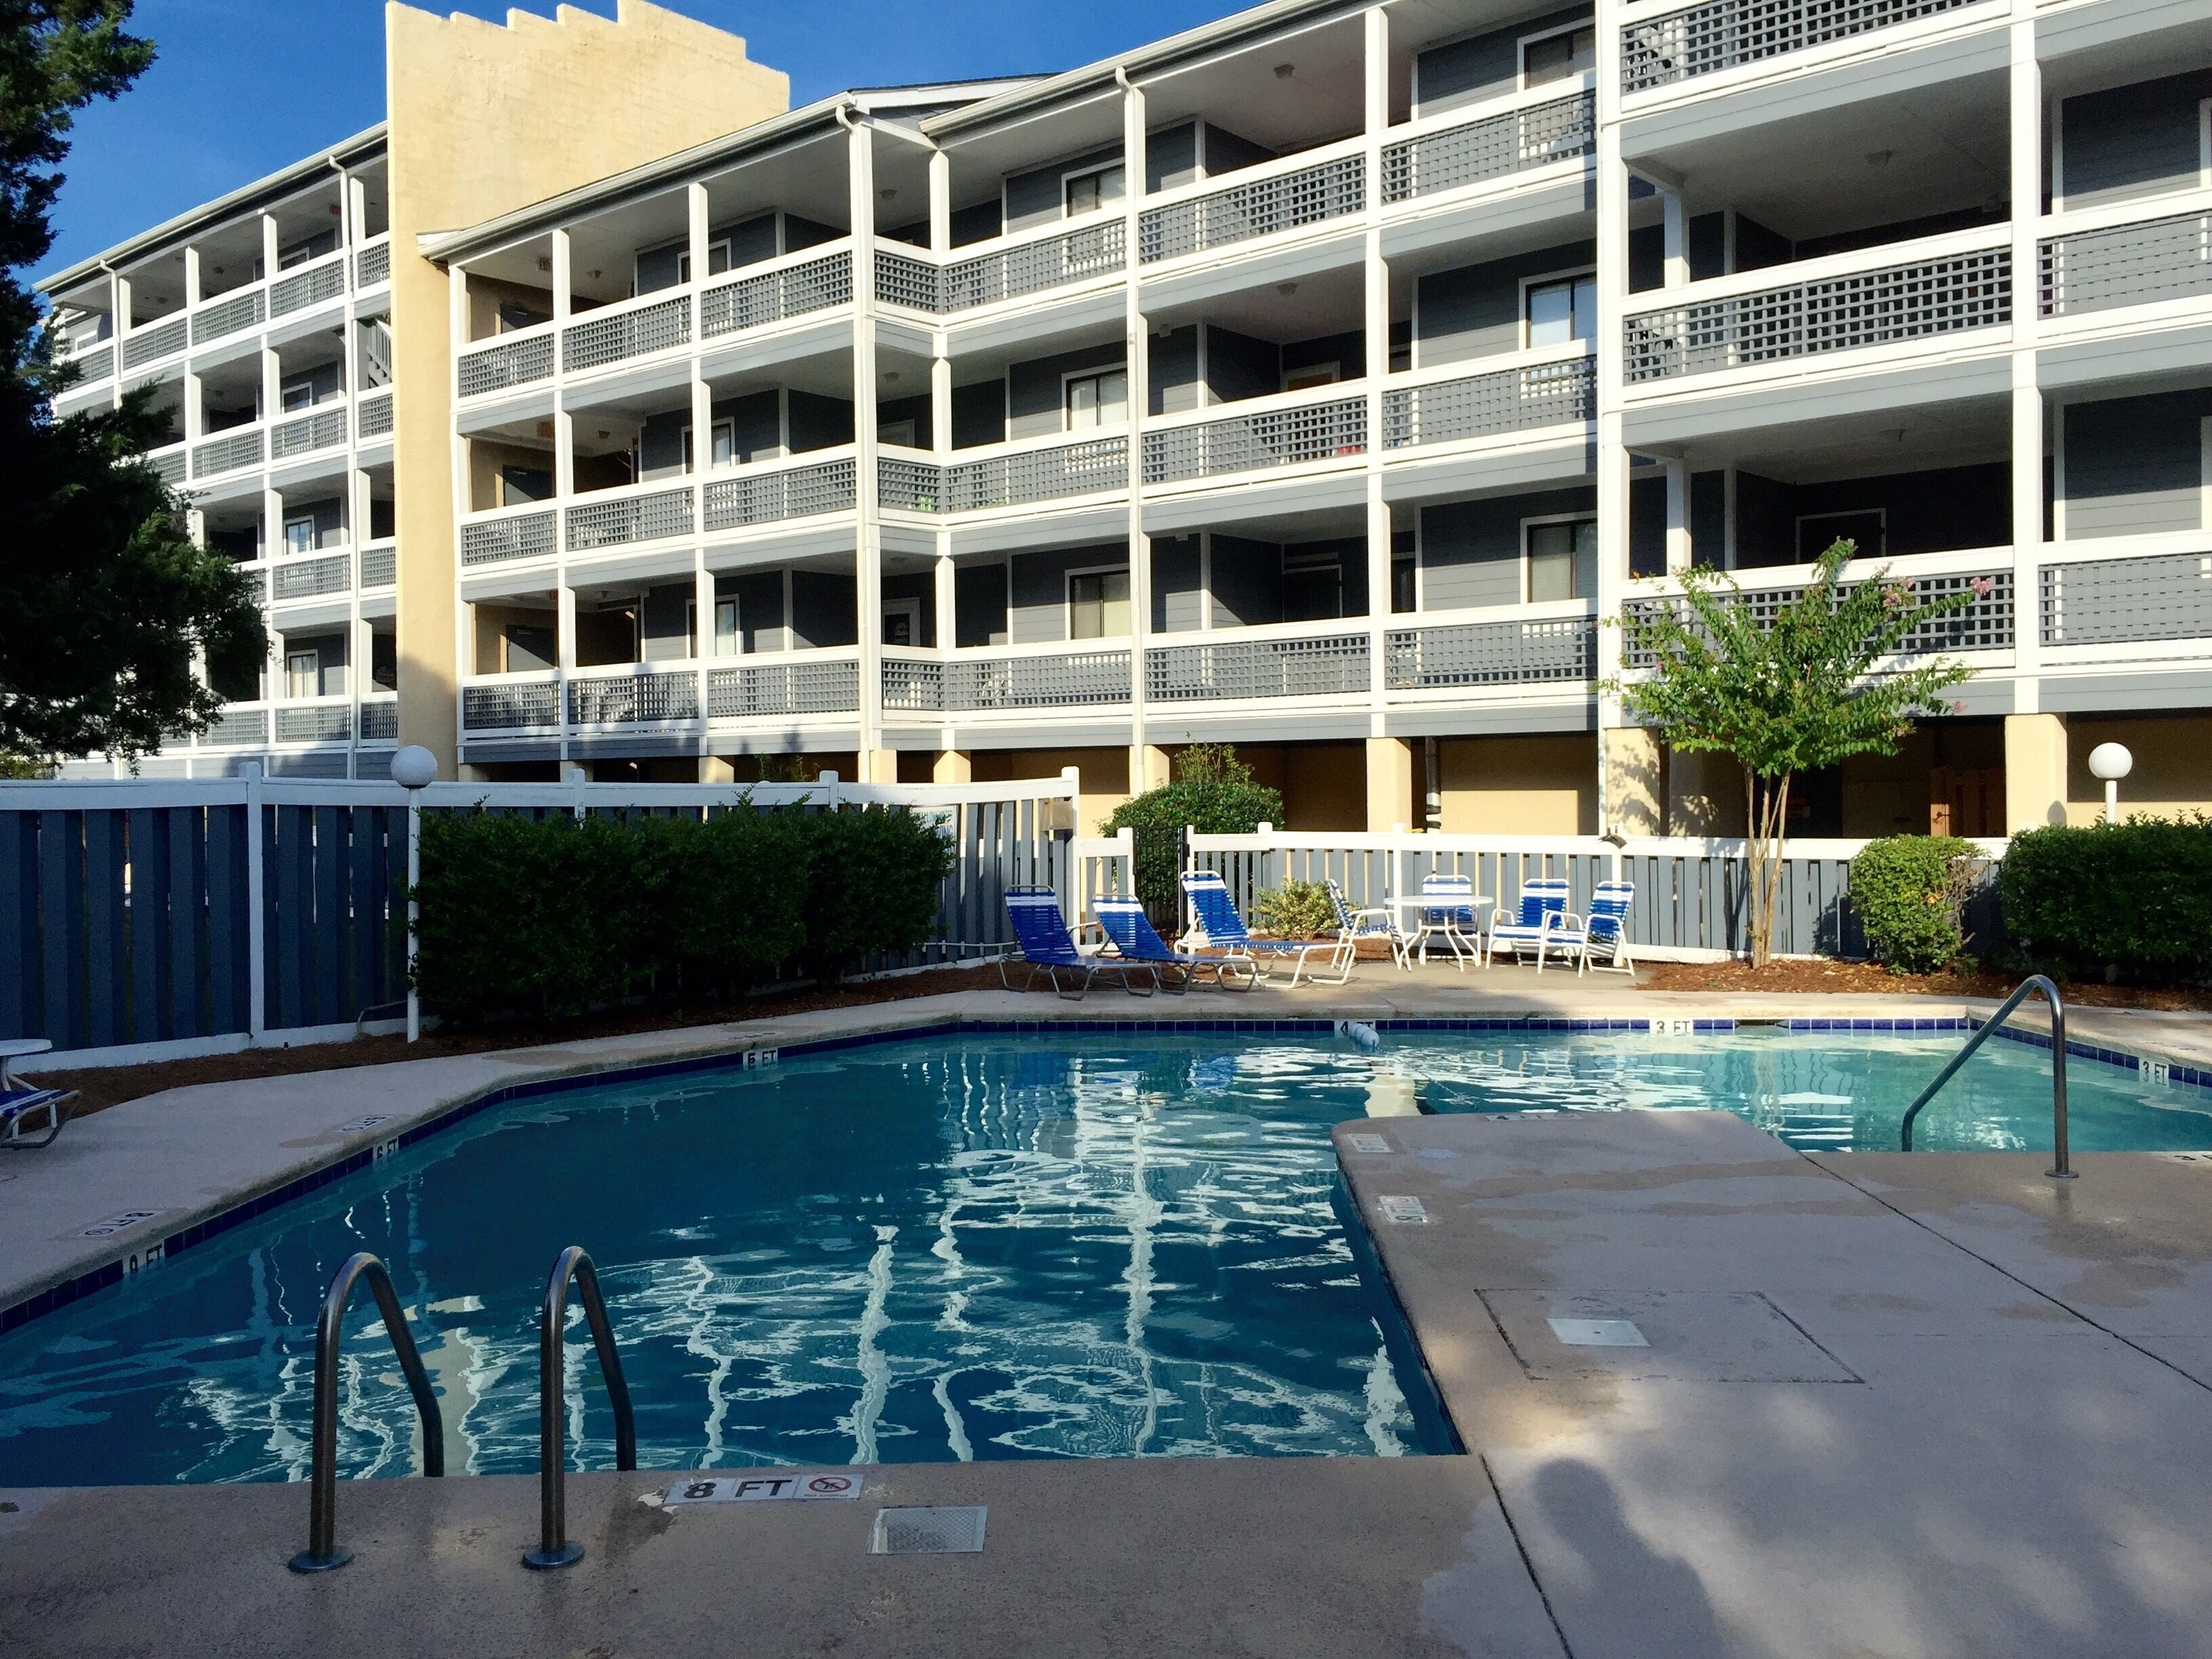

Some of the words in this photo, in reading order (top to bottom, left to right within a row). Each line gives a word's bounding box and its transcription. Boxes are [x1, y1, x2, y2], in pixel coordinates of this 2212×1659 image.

[1673, 1021, 1690, 1033] FT
[762, 1049, 777, 1061] FT
[2154, 1063, 2167, 1078] FT
[683, 1482, 716, 1499] 8
[735, 1479, 792, 1498] FT
